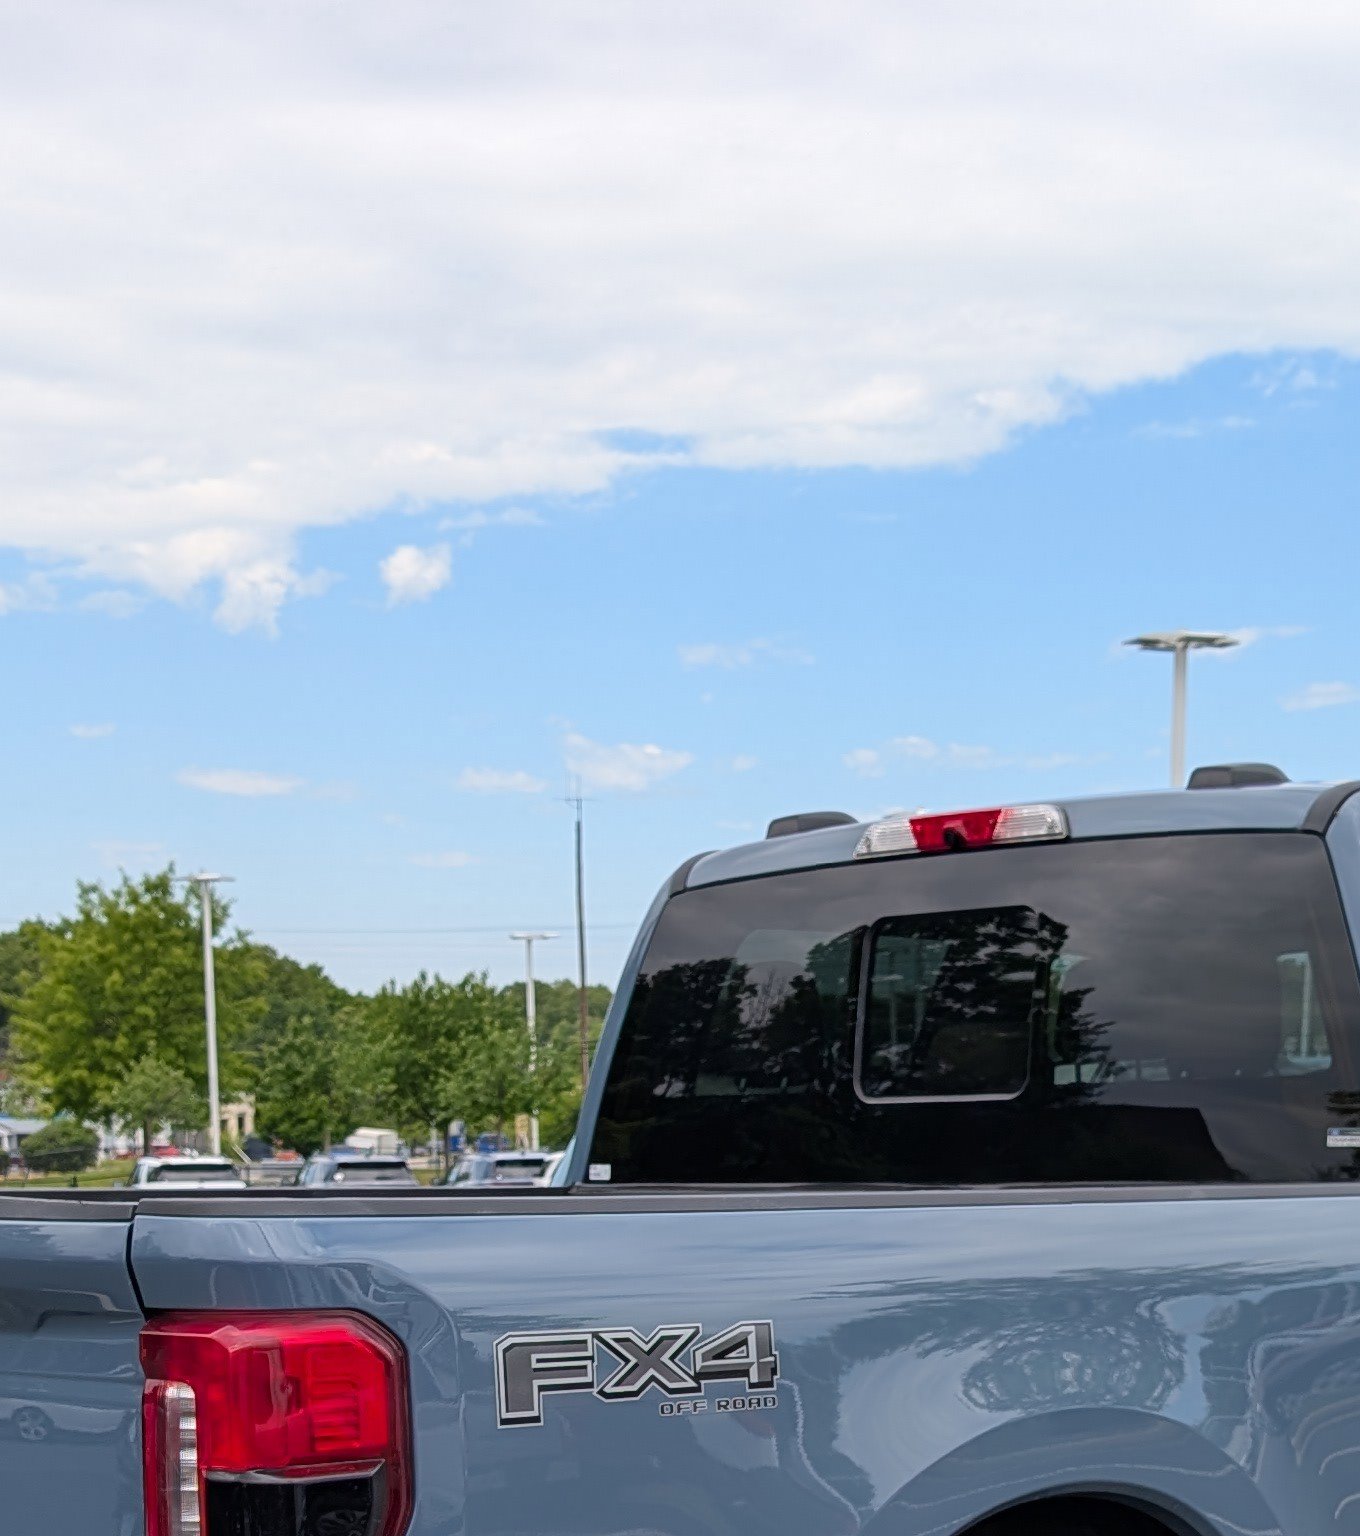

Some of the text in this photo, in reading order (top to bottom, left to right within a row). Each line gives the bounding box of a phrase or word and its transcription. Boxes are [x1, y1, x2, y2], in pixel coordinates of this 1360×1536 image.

[493, 1320, 780, 1429] FX4
[659, 1396, 779, 1417] OFF ROAD
